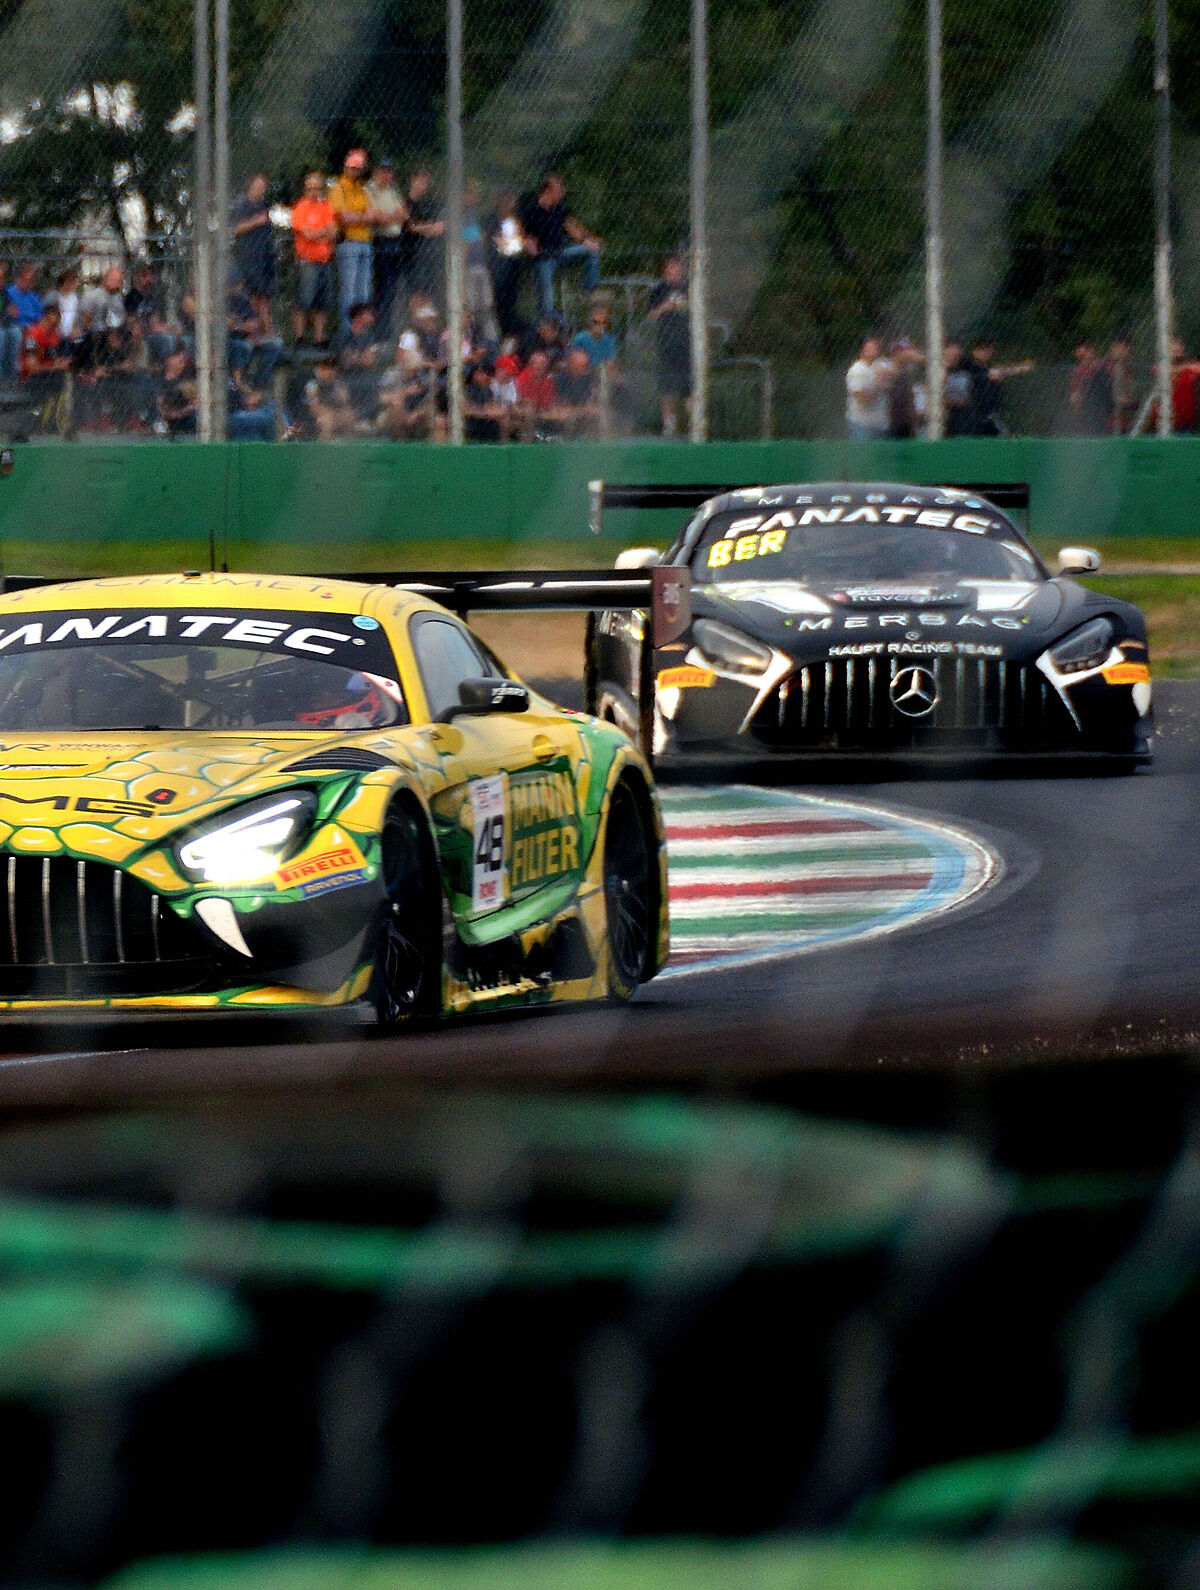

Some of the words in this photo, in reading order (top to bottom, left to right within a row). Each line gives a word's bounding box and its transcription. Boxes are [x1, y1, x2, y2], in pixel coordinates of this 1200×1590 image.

[723, 505, 992, 539] FANATEC
[707, 529, 787, 568] BER
[798, 613, 1023, 631] MERBAG
[828, 643, 884, 657] HAUPT
[887, 642, 951, 654] RACING
[955, 642, 1002, 656] TEAM
[277, 848, 357, 883] PIRELLI
